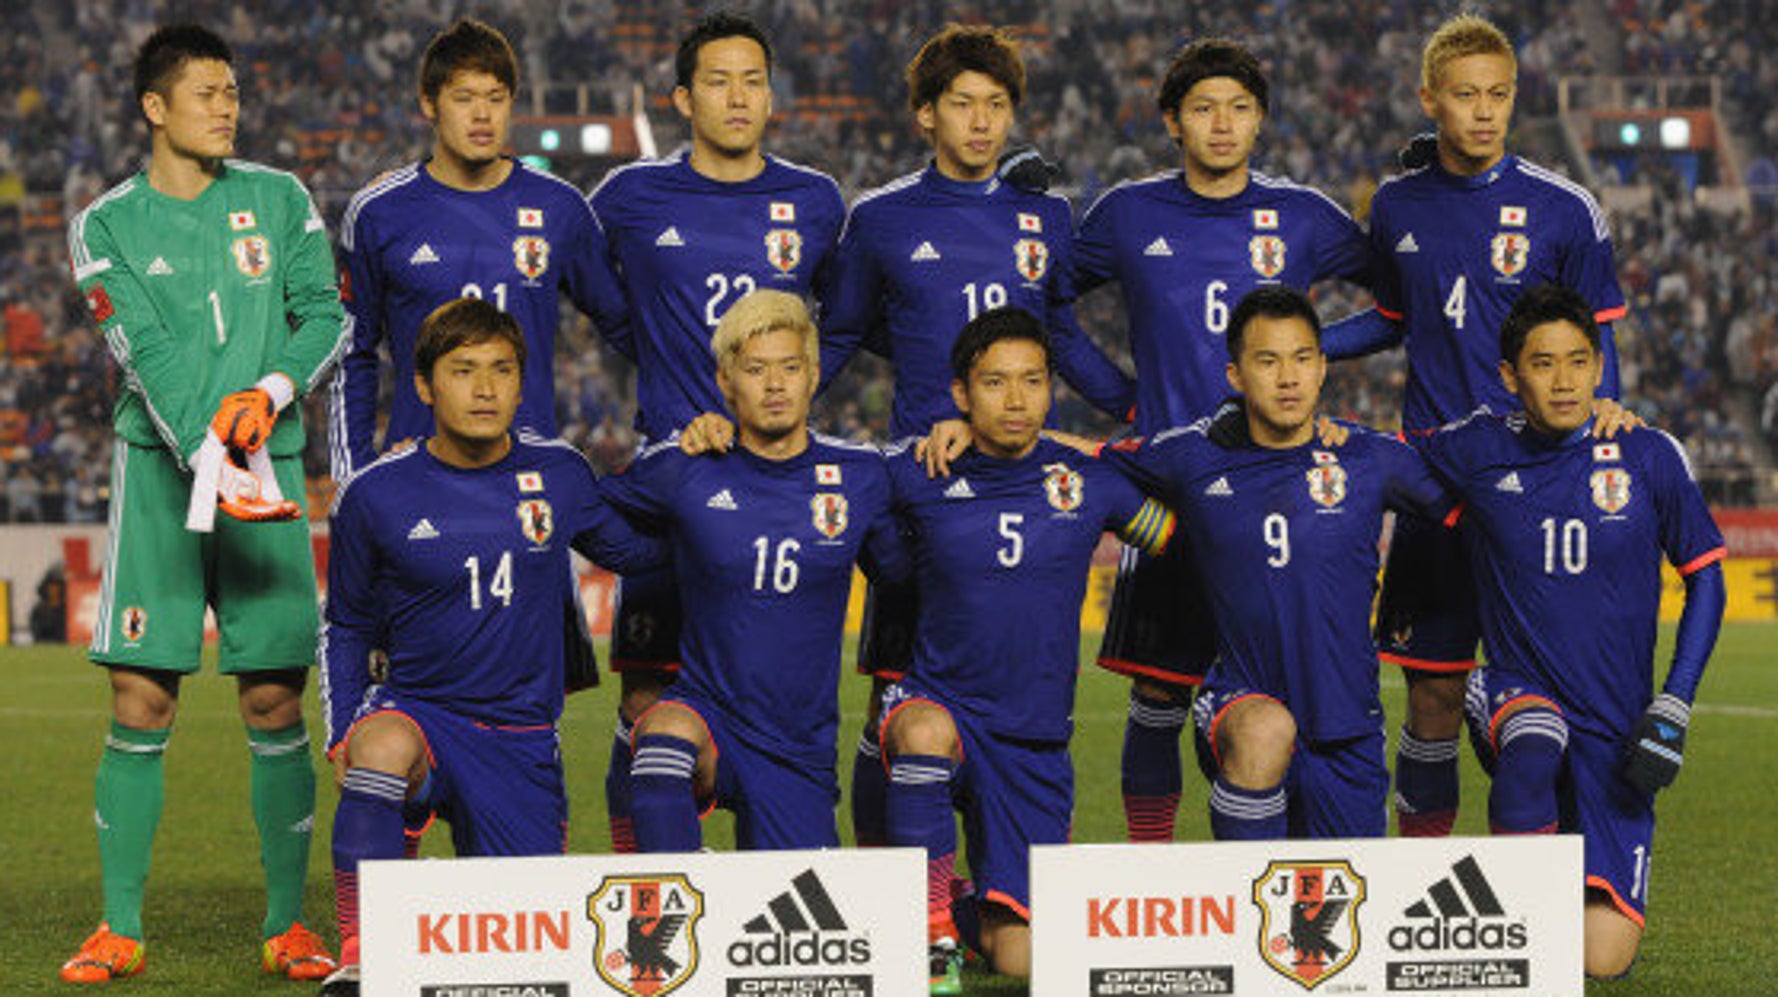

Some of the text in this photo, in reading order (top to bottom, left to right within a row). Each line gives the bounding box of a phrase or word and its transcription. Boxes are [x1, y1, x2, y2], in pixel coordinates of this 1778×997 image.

[208, 290, 227, 345] 1
[1206, 279, 1229, 333] 6
[1443, 275, 1466, 329] 4
[997, 512, 1023, 568] 5
[1264, 513, 1290, 568] 9
[1541, 518, 1588, 574] 10
[464, 550, 514, 610] 14
[753, 536, 800, 593] 16
[606, 887, 686, 912] JFA
[1271, 874, 1348, 897] JFA
[417, 910, 570, 954] KIRIN
[1087, 895, 1236, 938] KIRIN
[1387, 917, 1528, 950] adidas
[726, 932, 872, 966] adidas
[1401, 961, 1514, 976] OFFICIAL
[741, 978, 859, 991] OFFICIAL
[1104, 969, 1215, 982] OFFICIAL
